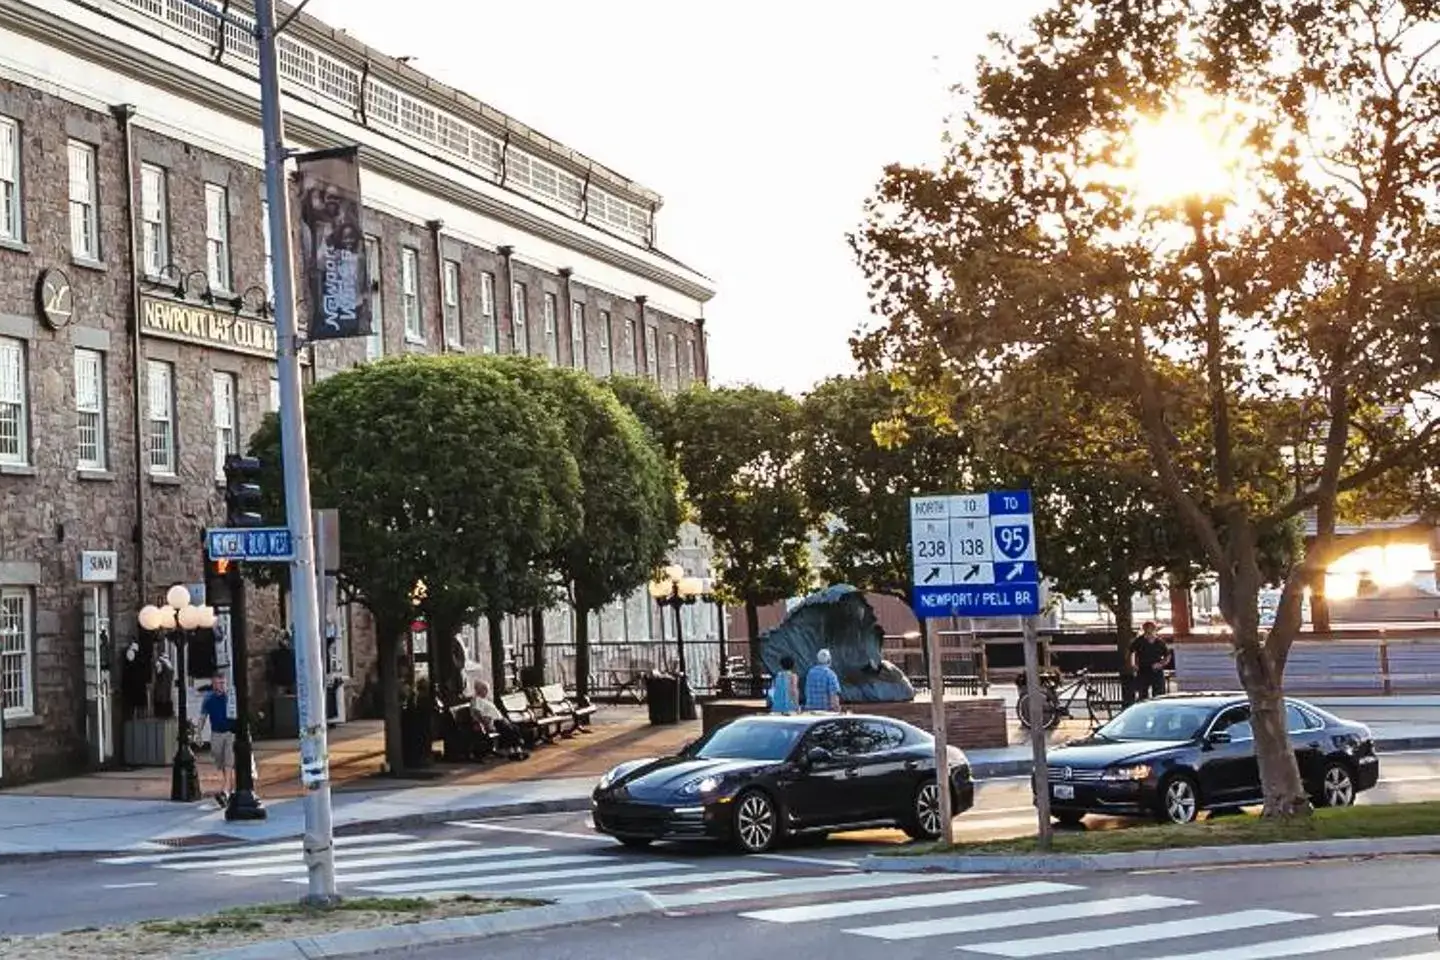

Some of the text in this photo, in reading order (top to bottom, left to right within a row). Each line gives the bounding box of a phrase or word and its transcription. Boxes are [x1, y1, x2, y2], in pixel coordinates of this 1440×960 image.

[144, 299, 206, 339] NEWPORT
[210, 315, 233, 341] BAY
[234, 321, 262, 348] CLUB
[915, 501, 945, 515] NORTH
[963, 498, 977, 513] TO
[1003, 496, 1019, 510] TO
[960, 538, 985, 556] 138
[1001, 527, 1025, 553] 95
[917, 539, 946, 559] 238
[921, 592, 973, 608] NEWPORT
[982, 592, 1011, 606] PELL
